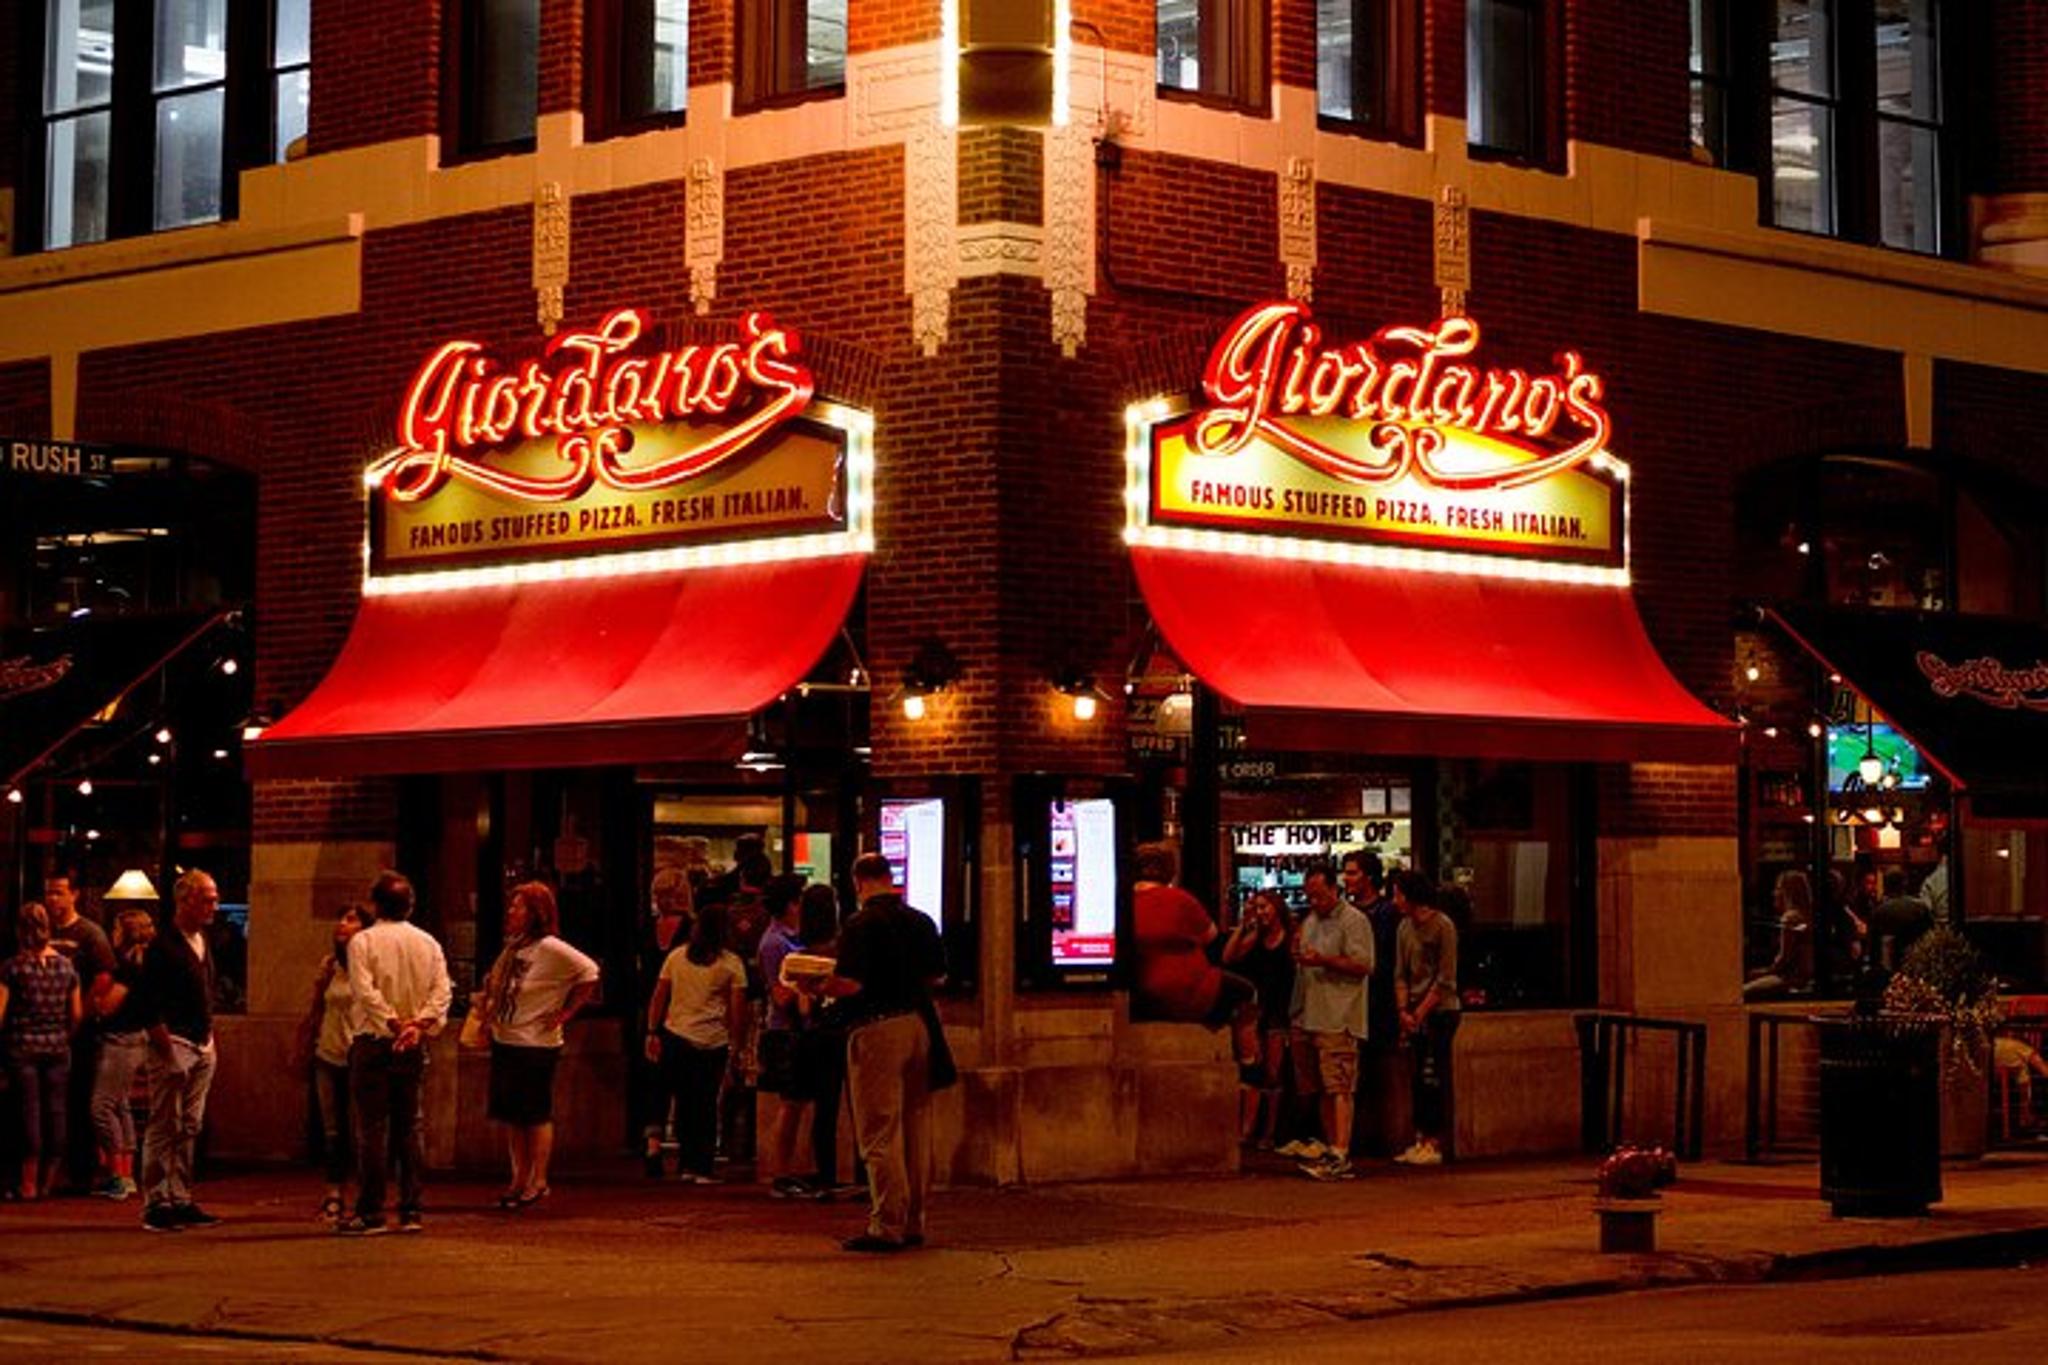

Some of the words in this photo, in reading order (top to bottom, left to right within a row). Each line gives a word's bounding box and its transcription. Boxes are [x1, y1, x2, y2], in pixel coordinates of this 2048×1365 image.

[384, 306, 816, 501] Giordano's
[1182, 301, 1612, 491] Giordano's
[10, 441, 81, 476] RUSH
[89, 453, 106, 471] ST
[410, 520, 486, 550] FAMOUS
[490, 510, 570, 542] STUFFED
[579, 504, 643, 533] PIZZA.
[651, 496, 715, 525] FRESH
[723, 486, 810, 520] ITALIAN.
[1190, 479, 1275, 511] FAMOUS
[1283, 488, 1367, 520] STUFFED
[1375, 497, 1438, 526] PIZZA.
[1446, 505, 1504, 533] FRESH
[1512, 512, 1588, 541] ITALIAN.
[1233, 823, 1275, 846] THE
[1286, 822, 1353, 845] HOME
[1363, 820, 1394, 843] OF
